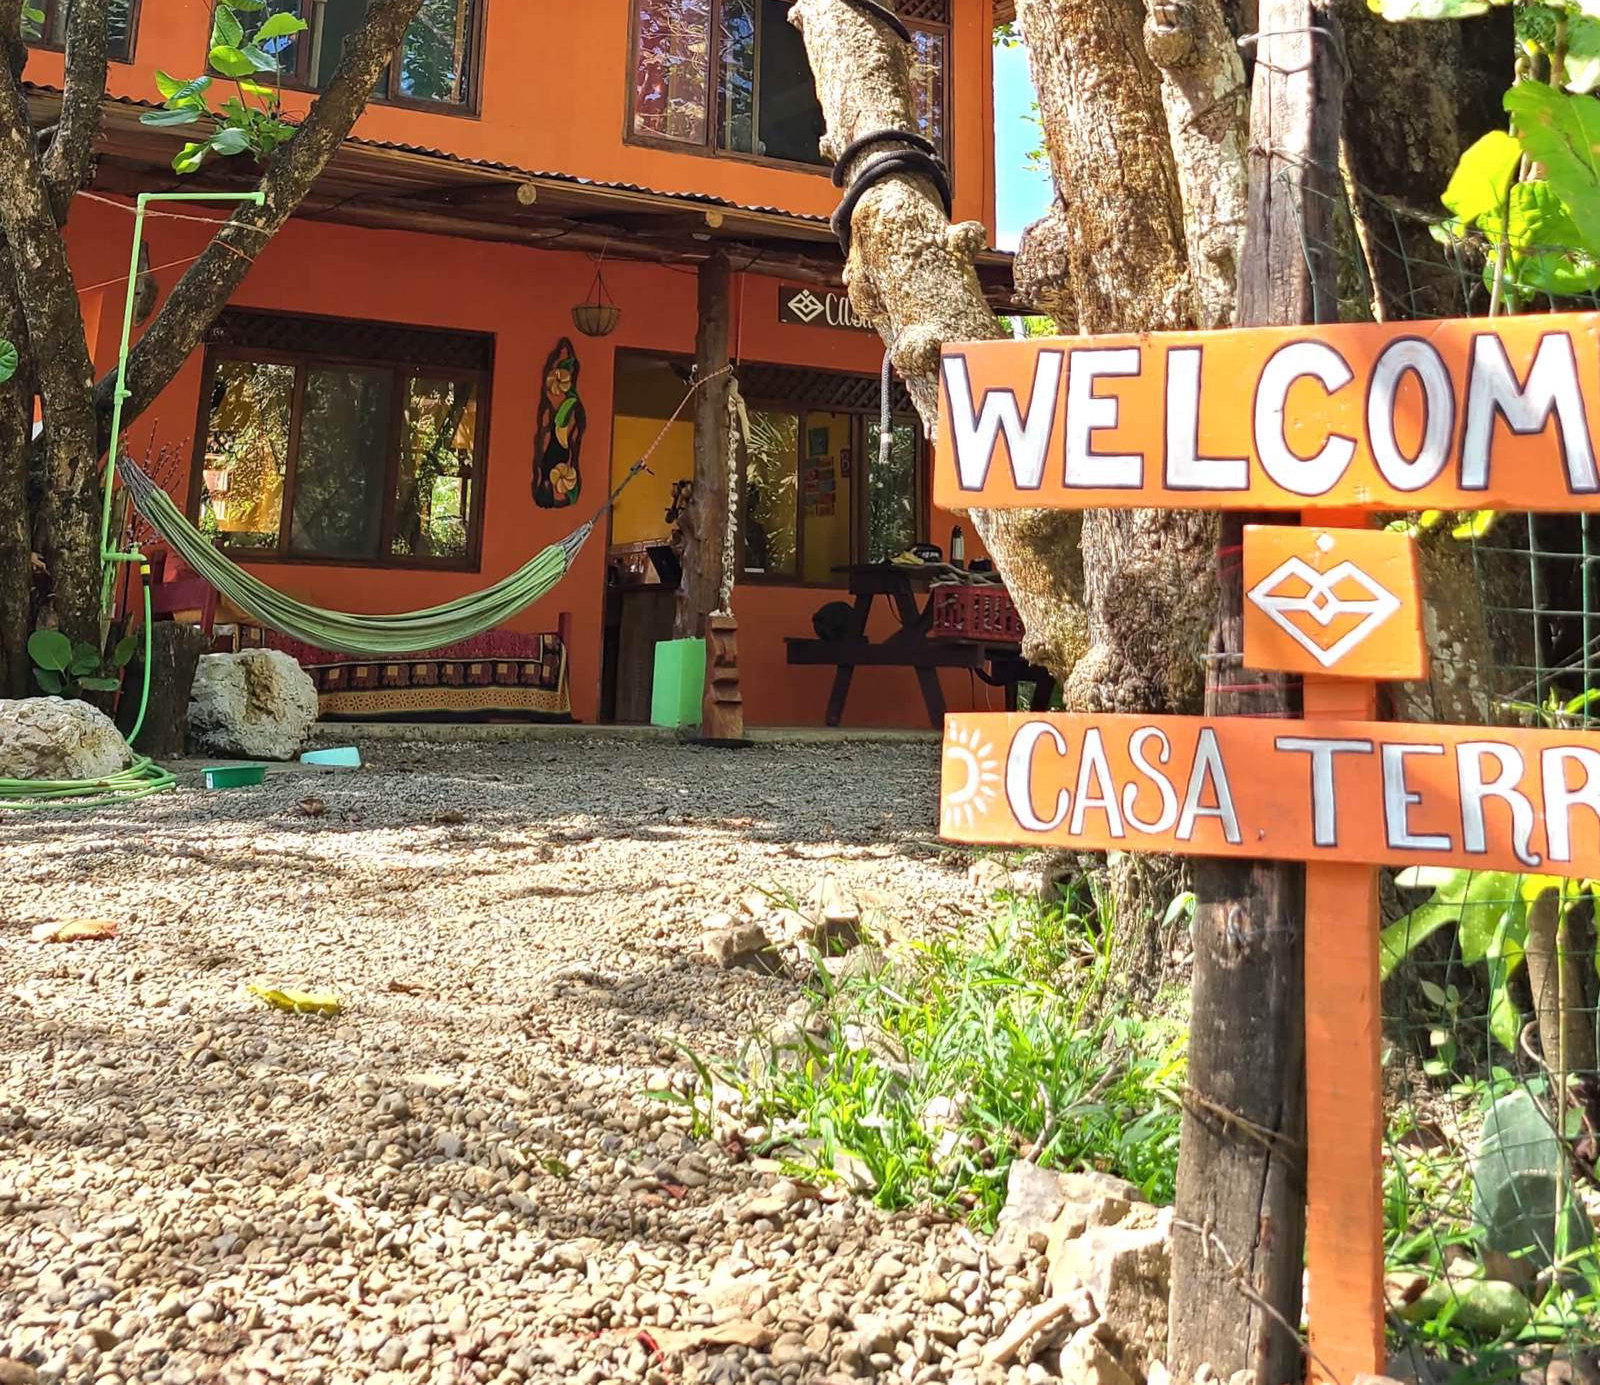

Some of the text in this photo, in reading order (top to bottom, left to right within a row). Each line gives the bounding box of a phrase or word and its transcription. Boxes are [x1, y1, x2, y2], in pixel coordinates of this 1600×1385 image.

[941, 332, 1600, 497] WELCOM
[1005, 720, 1600, 867] CASA TERR
